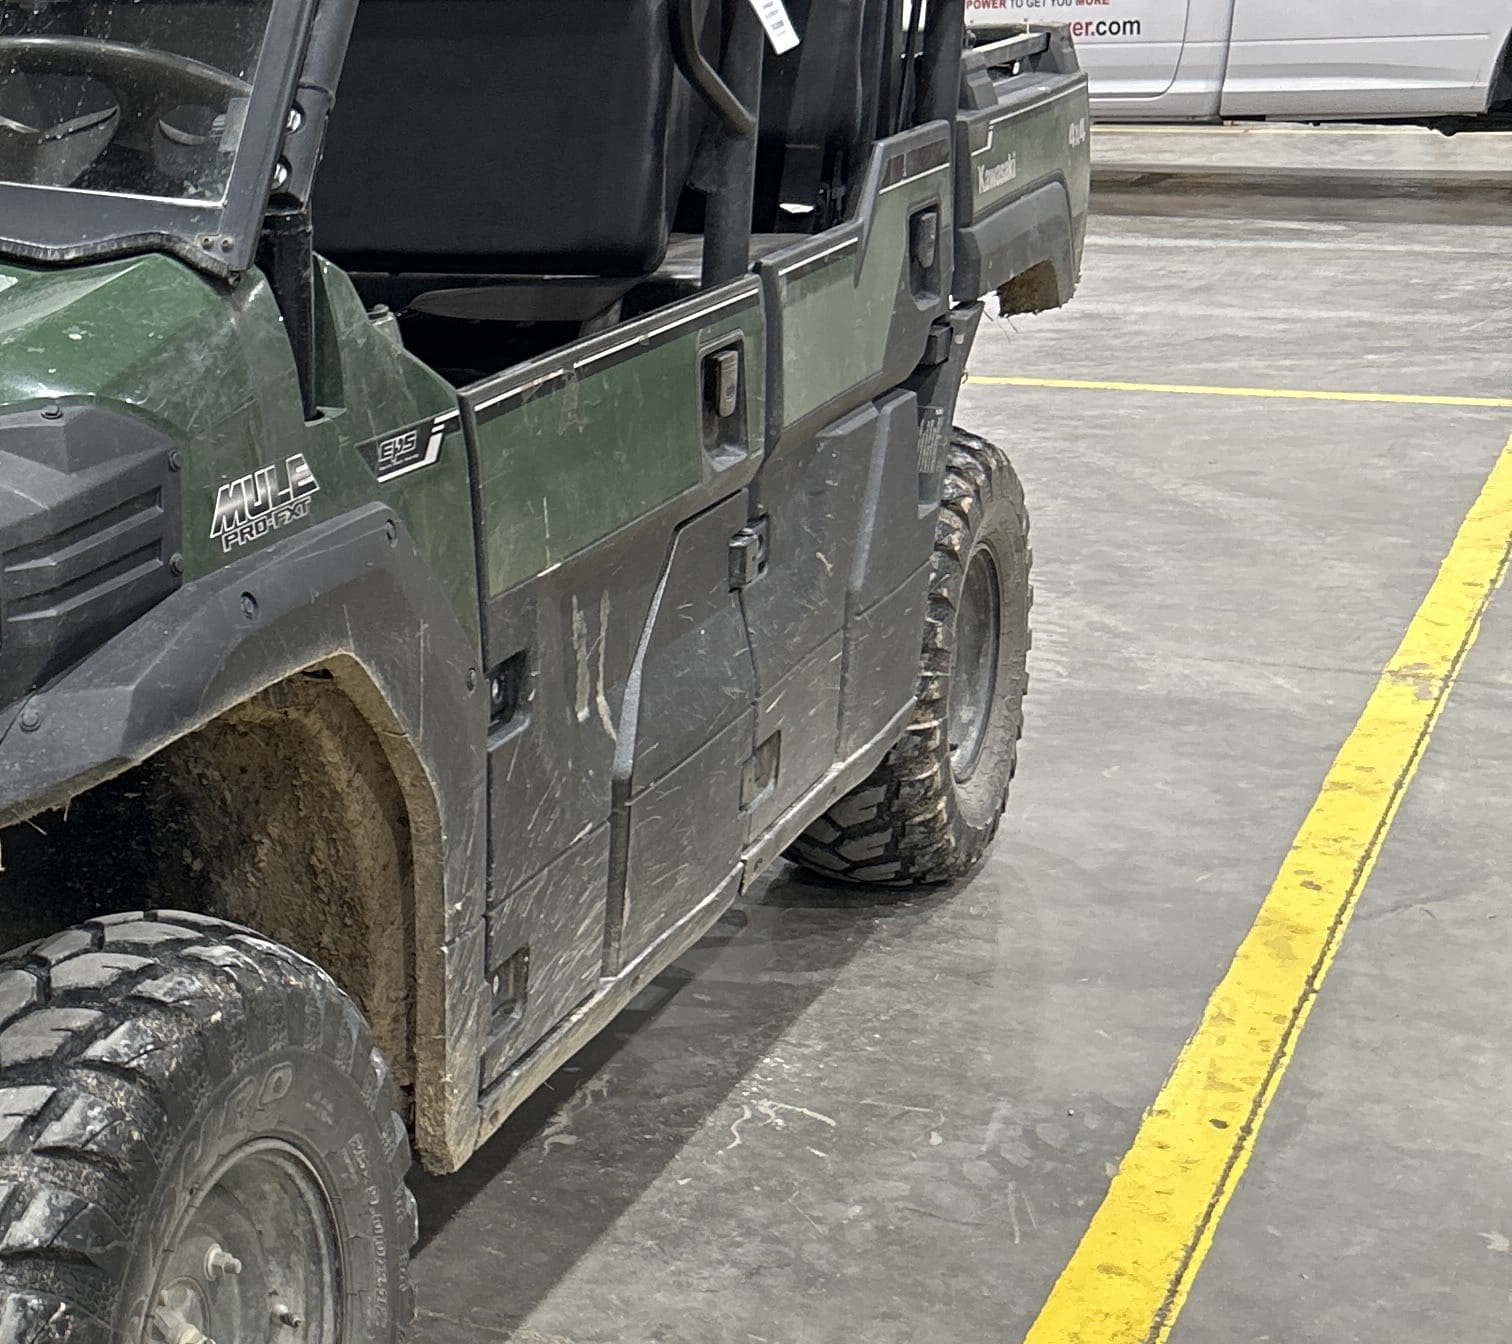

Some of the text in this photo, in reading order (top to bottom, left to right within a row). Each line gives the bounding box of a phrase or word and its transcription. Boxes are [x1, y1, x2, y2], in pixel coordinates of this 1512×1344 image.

[1070, 19, 1141, 37] er.com
[378, 430, 417, 463] EPS
[209, 453, 321, 539] MULE
[221, 496, 312, 553] PRO-FXT
